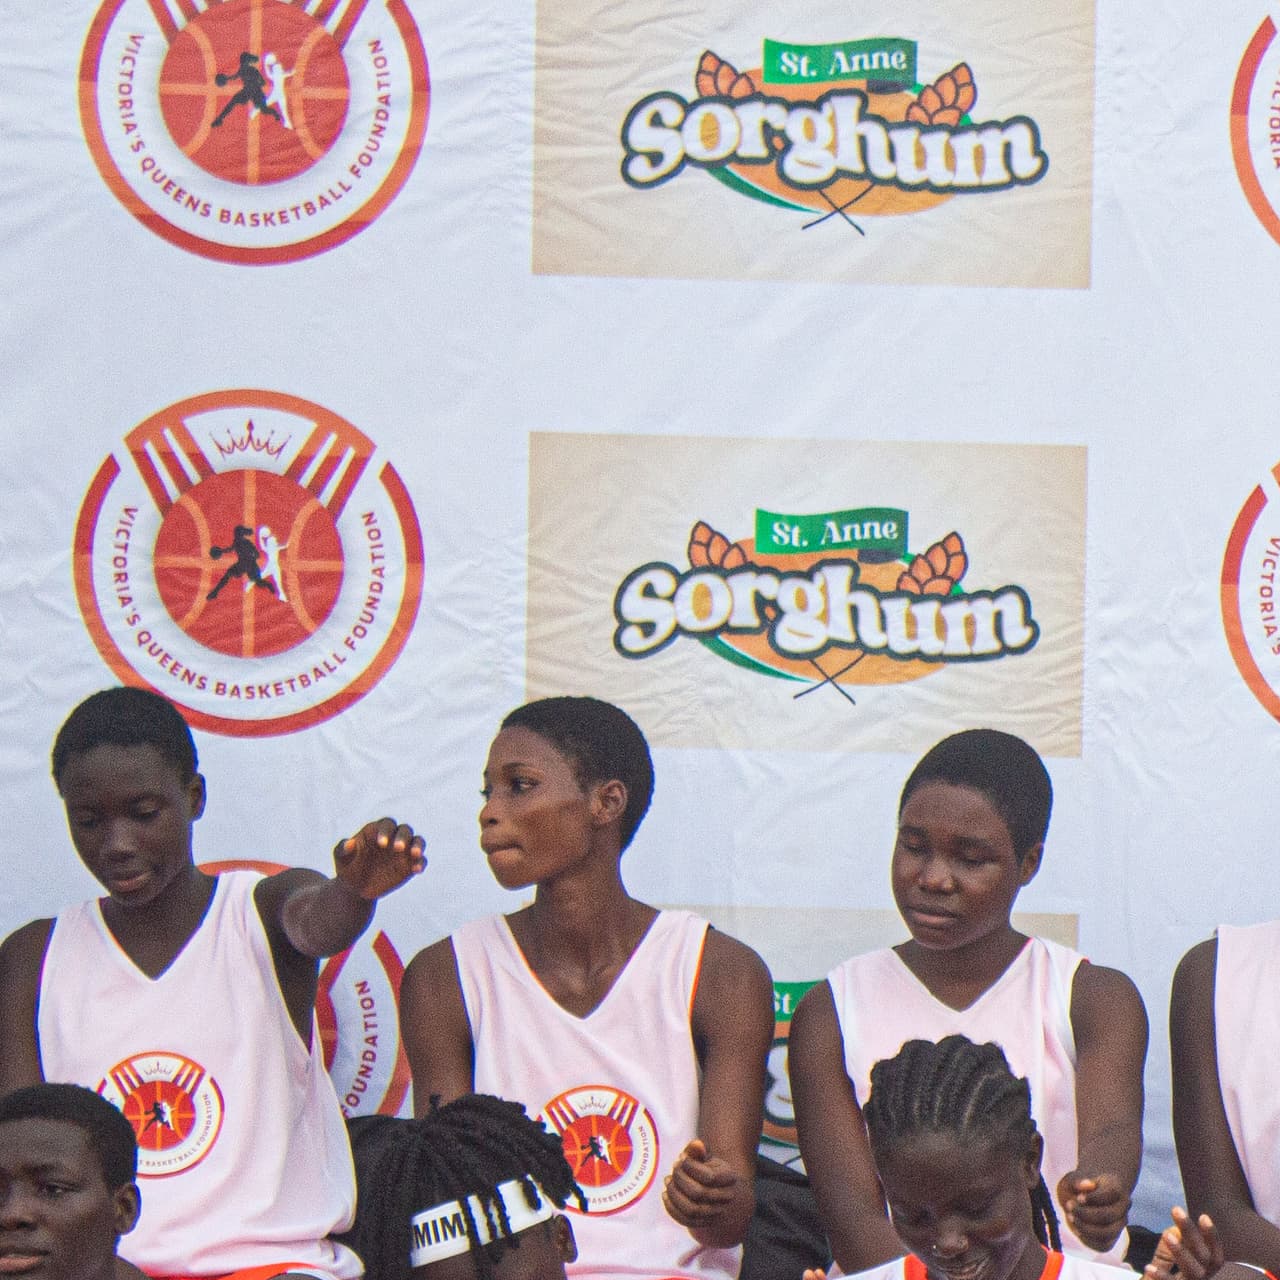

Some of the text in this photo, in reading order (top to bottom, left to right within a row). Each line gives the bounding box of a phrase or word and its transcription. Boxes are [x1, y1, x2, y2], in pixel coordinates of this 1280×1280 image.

[780, 48, 908, 78] St. Anne
[119, 33, 392, 228] VICTORIA'S QUEENS BASKETBALL FOUNDATION
[623, 92, 1047, 190] Sorghum
[771, 519, 899, 548] St. Anne
[111, 504, 387, 701] VICTORIA'S QUEENS BASKETBALL FOUNDATION
[616, 563, 1038, 660] Sorghum
